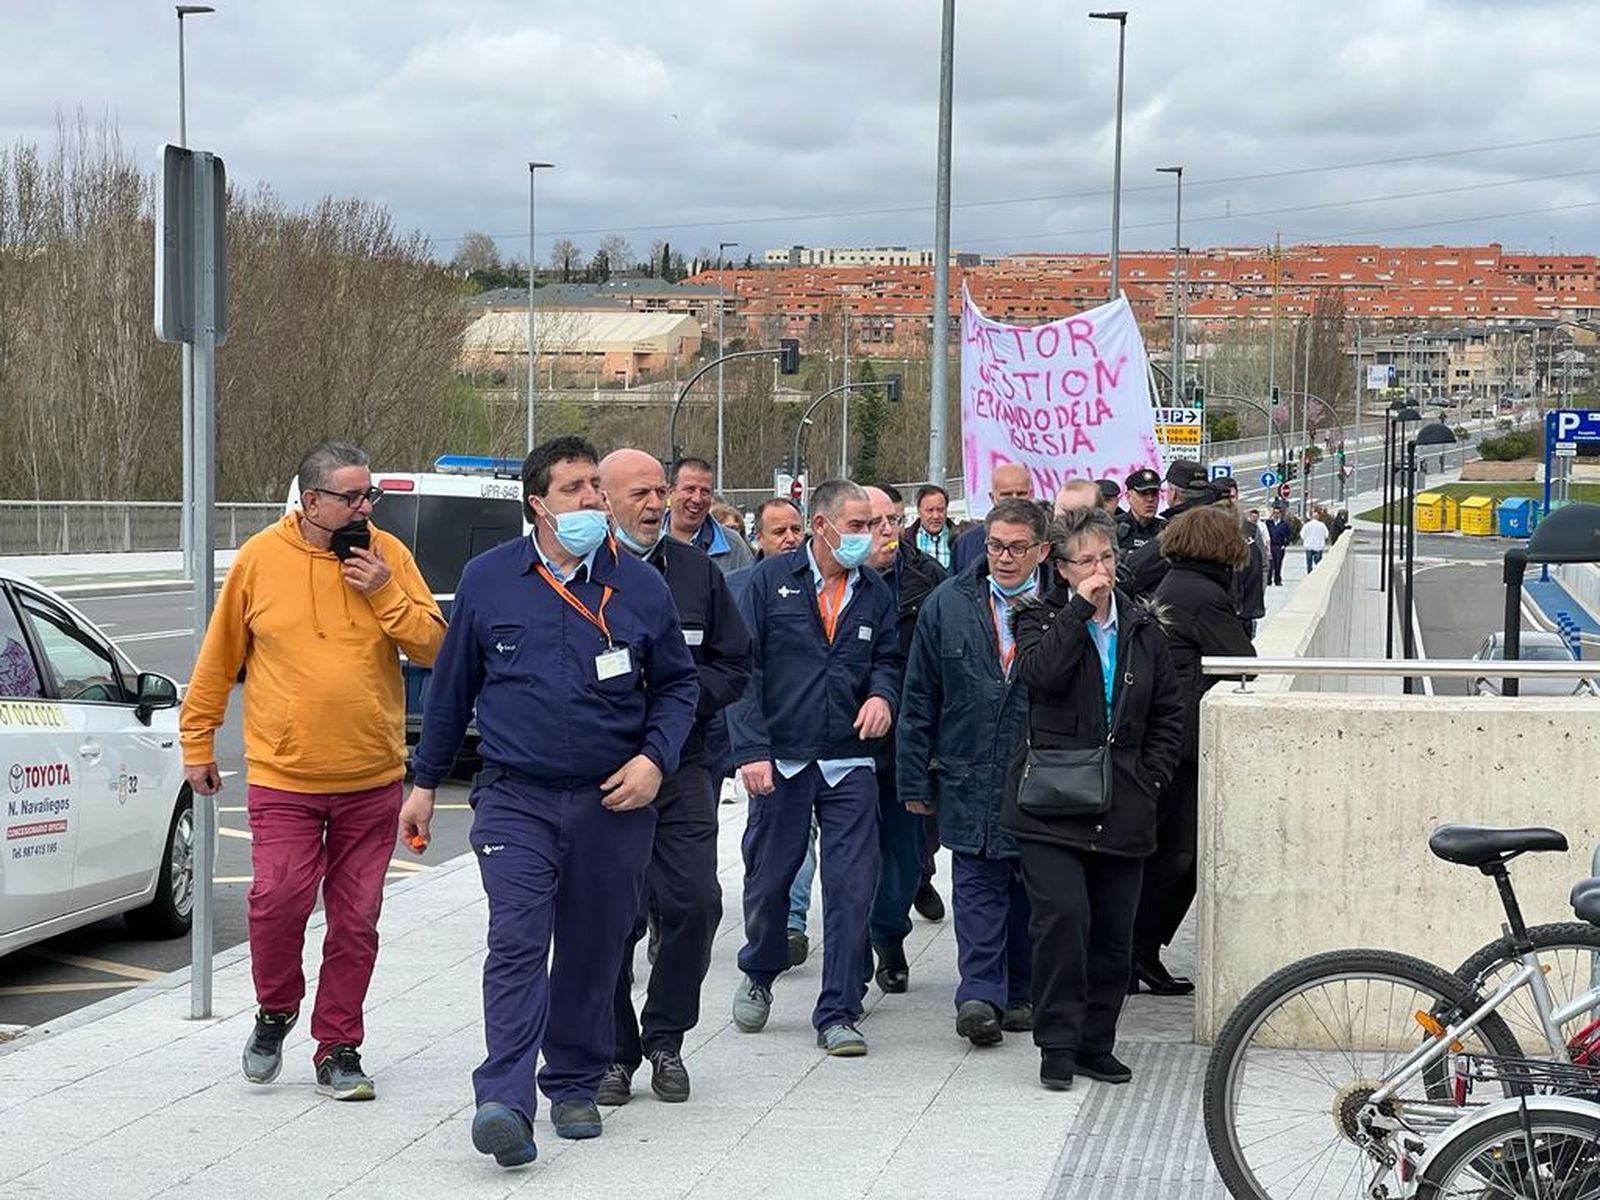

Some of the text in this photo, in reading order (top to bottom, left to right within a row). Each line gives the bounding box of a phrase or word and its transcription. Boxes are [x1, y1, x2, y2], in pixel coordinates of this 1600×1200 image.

[1559, 412, 1580, 439] P
[25, 764, 71, 788] TOYOTA
[128, 775, 138, 794] 32
[8, 800, 18, 816] N.
